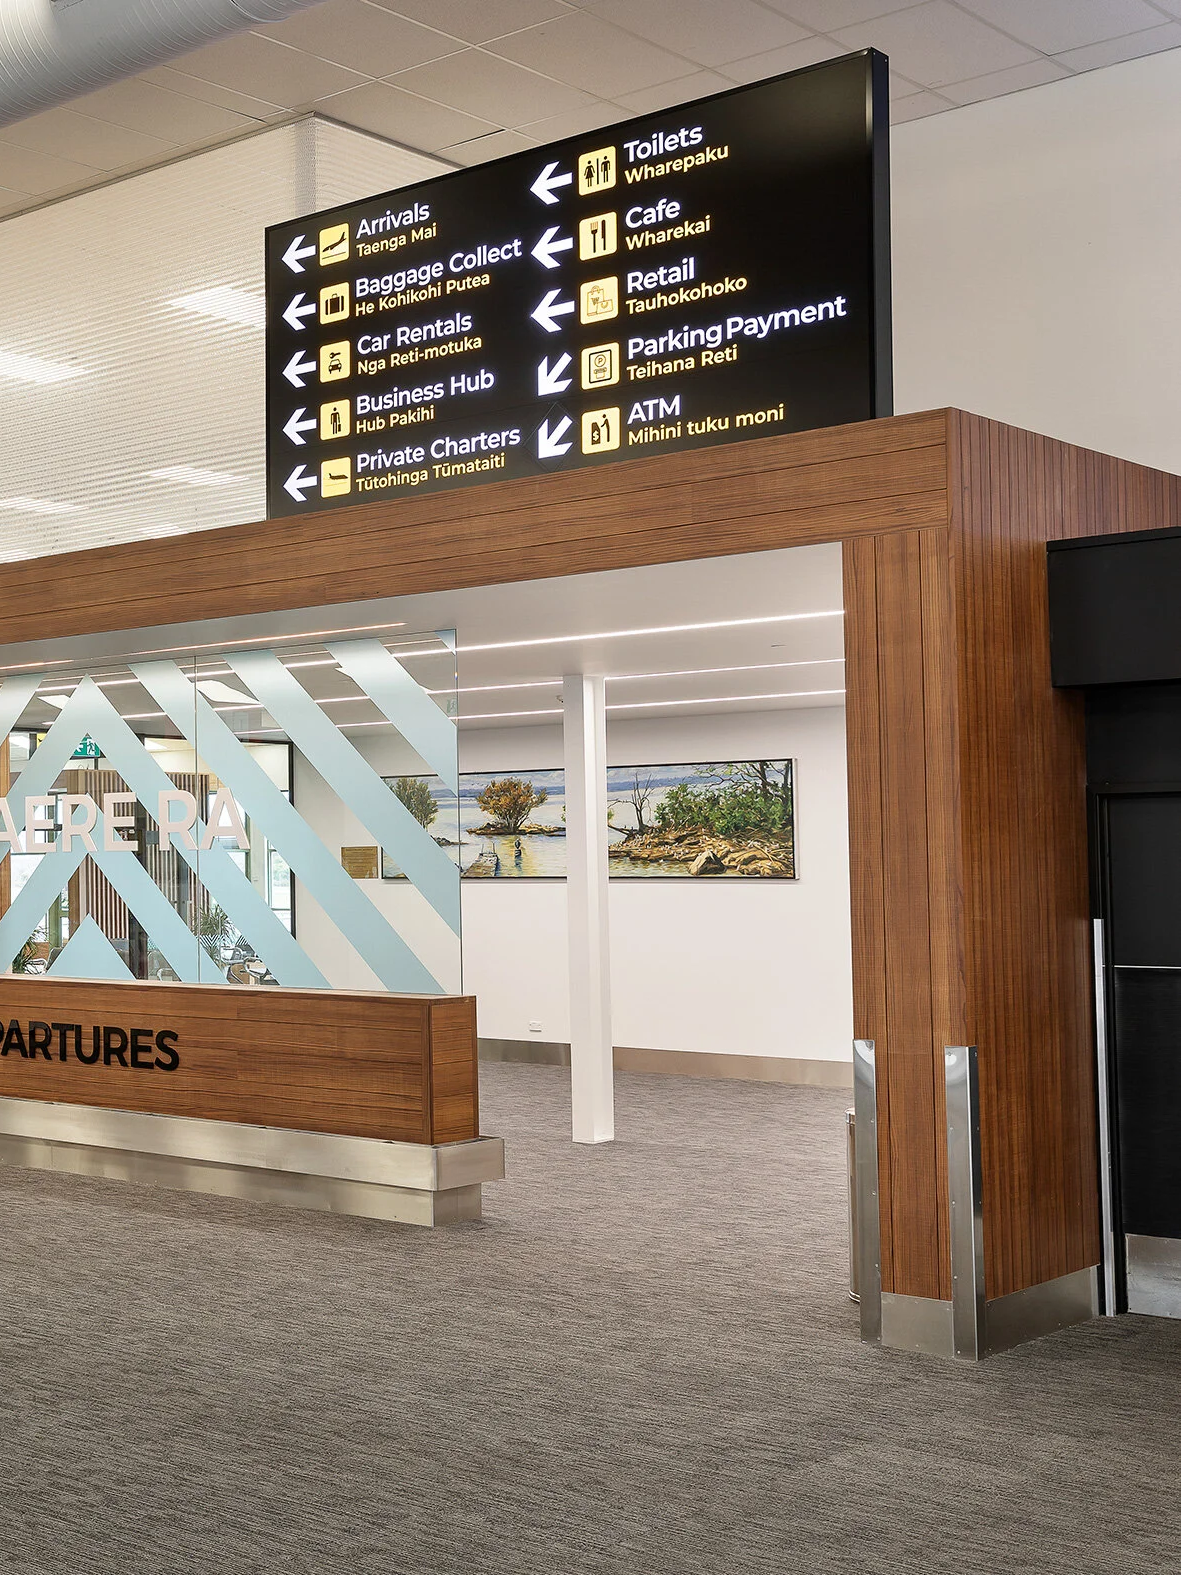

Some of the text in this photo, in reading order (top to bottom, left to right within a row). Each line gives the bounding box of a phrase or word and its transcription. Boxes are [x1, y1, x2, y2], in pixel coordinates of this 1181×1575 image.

[624, 127, 702, 162] Toilets
[625, 146, 728, 184] Wharepaku
[356, 203, 429, 239] Arrivals
[626, 199, 680, 228] Cafe
[626, 215, 710, 250] Wharekai
[356, 222, 436, 257] Taenga Mai
[356, 239, 522, 297] Baggage Collect
[628, 257, 694, 293] Retail
[356, 274, 490, 316] He Kohikohi Putea
[626, 277, 747, 314] Tauhokohoko
[358, 313, 472, 354] Car Rentals
[629, 296, 846, 359] Parking Payment
[358, 337, 481, 375] Nga Reti-motuka
[626, 344, 737, 380] Teihana Reti
[357, 369, 494, 414] Business Hub
[627, 395, 680, 424] ATM
[357, 405, 434, 434] Hub Pakihi
[629, 404, 783, 445] Mihini tuku moni
[357, 429, 520, 472] Private Charters
[356, 452, 504, 491] Tūtohinga Tūmataiti
[158, 788, 251, 851] RA
